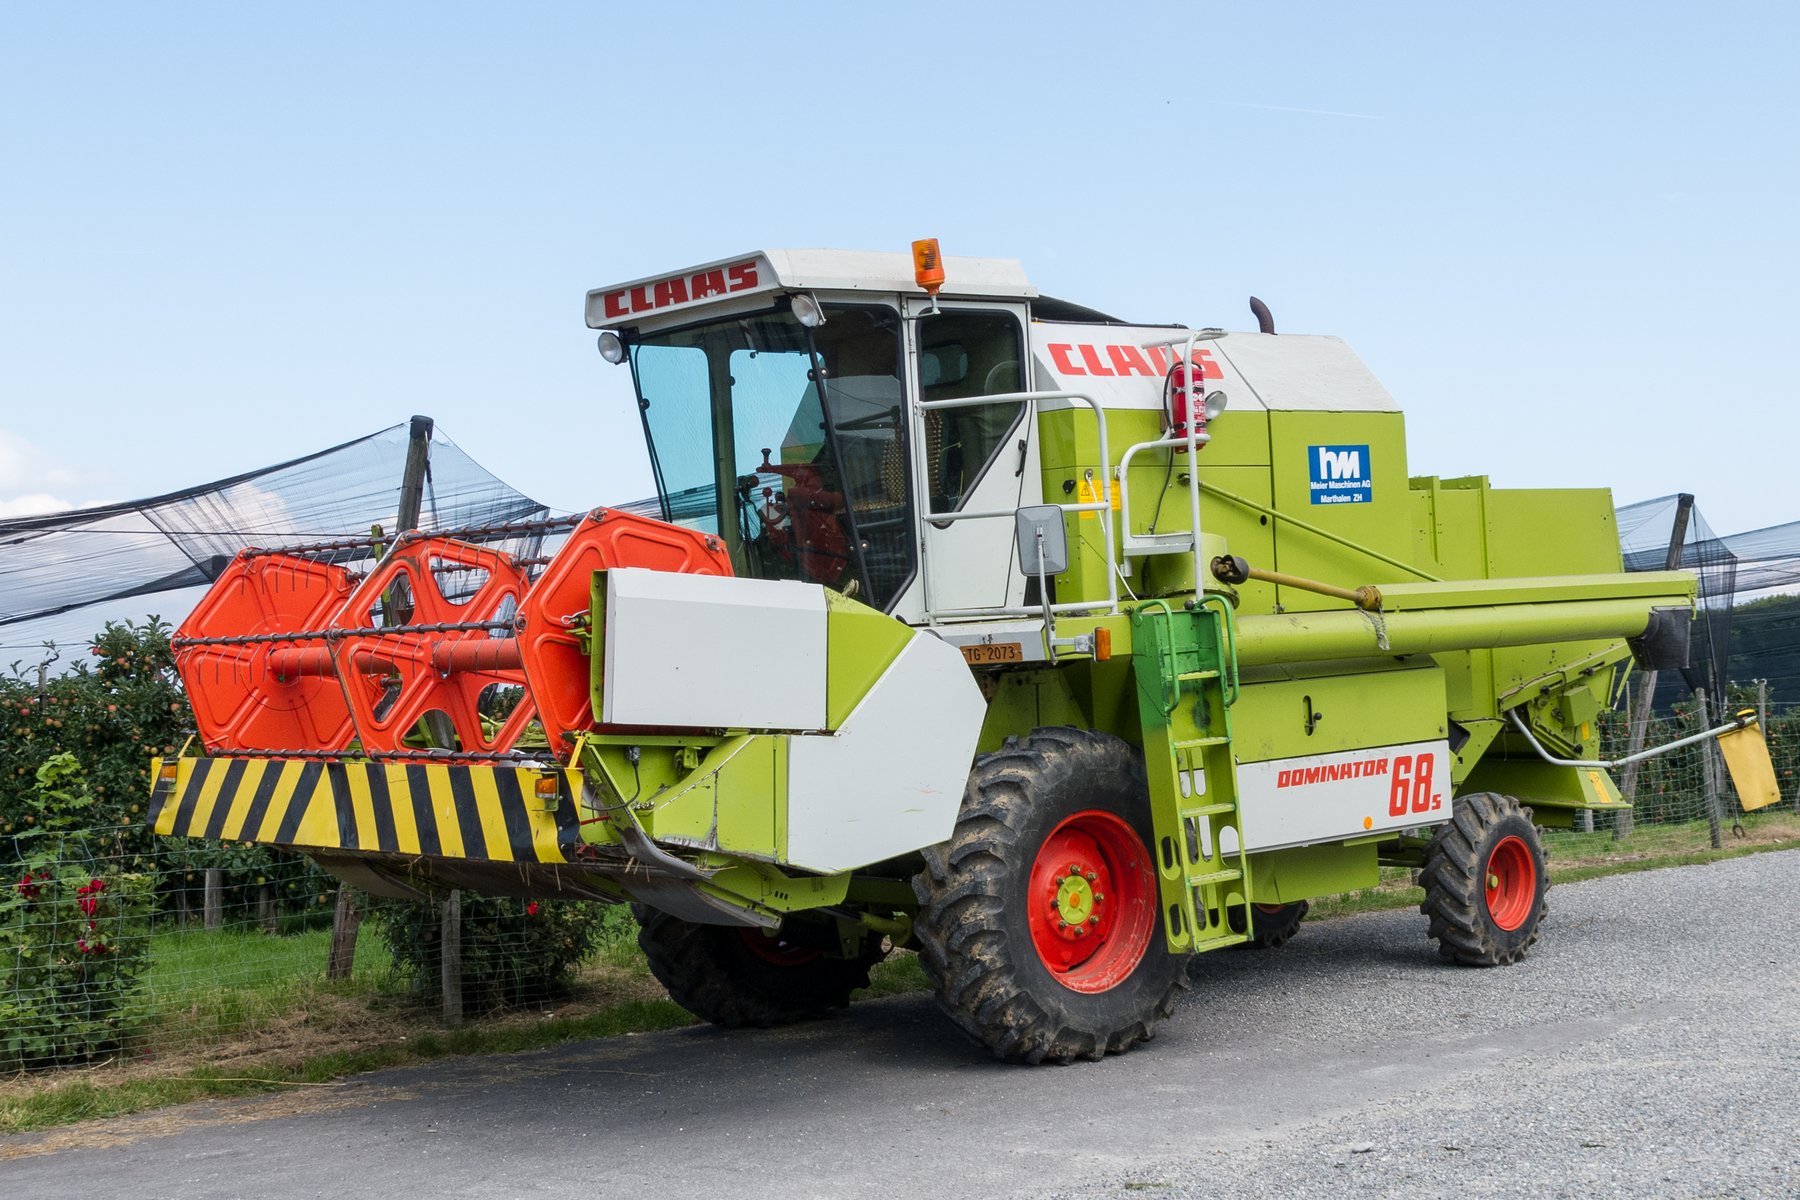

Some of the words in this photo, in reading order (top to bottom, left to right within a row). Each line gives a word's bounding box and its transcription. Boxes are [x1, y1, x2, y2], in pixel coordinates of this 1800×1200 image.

[603, 261, 759, 319] CLAAS
[1310, 481, 1328, 490] Meier
[1328, 480, 1361, 489] Maschinen
[1361, 479, 1371, 488] AG
[1320, 494, 1351, 503] Marthalen
[1352, 493, 1363, 502] ZH
[1277, 758, 1389, 789] DOMINATOR
